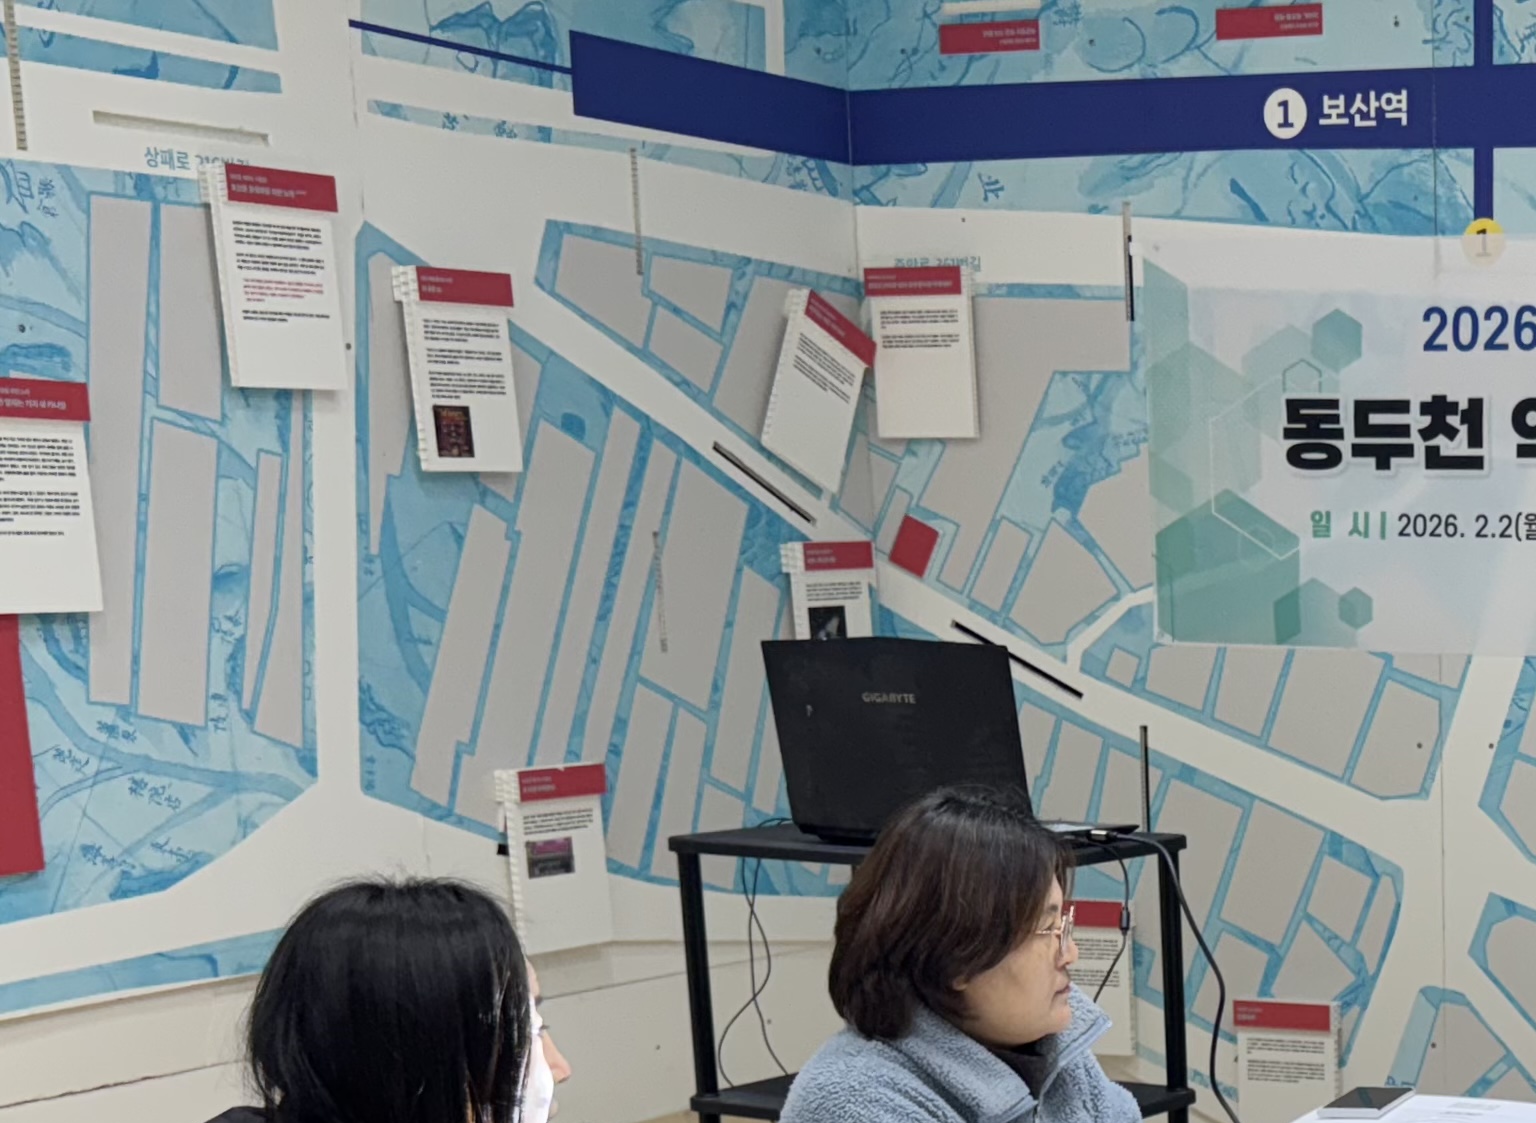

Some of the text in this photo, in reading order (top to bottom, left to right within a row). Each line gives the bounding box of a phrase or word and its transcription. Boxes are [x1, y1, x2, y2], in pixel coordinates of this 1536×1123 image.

[1277, 88, 1408, 129] 1 보산역
[145, 147, 191, 171] 상패로
[1283, 394, 1485, 471] 동두천
[1397, 513, 1465, 538] 2026.
[862, 692, 916, 704] GIGABYTE
